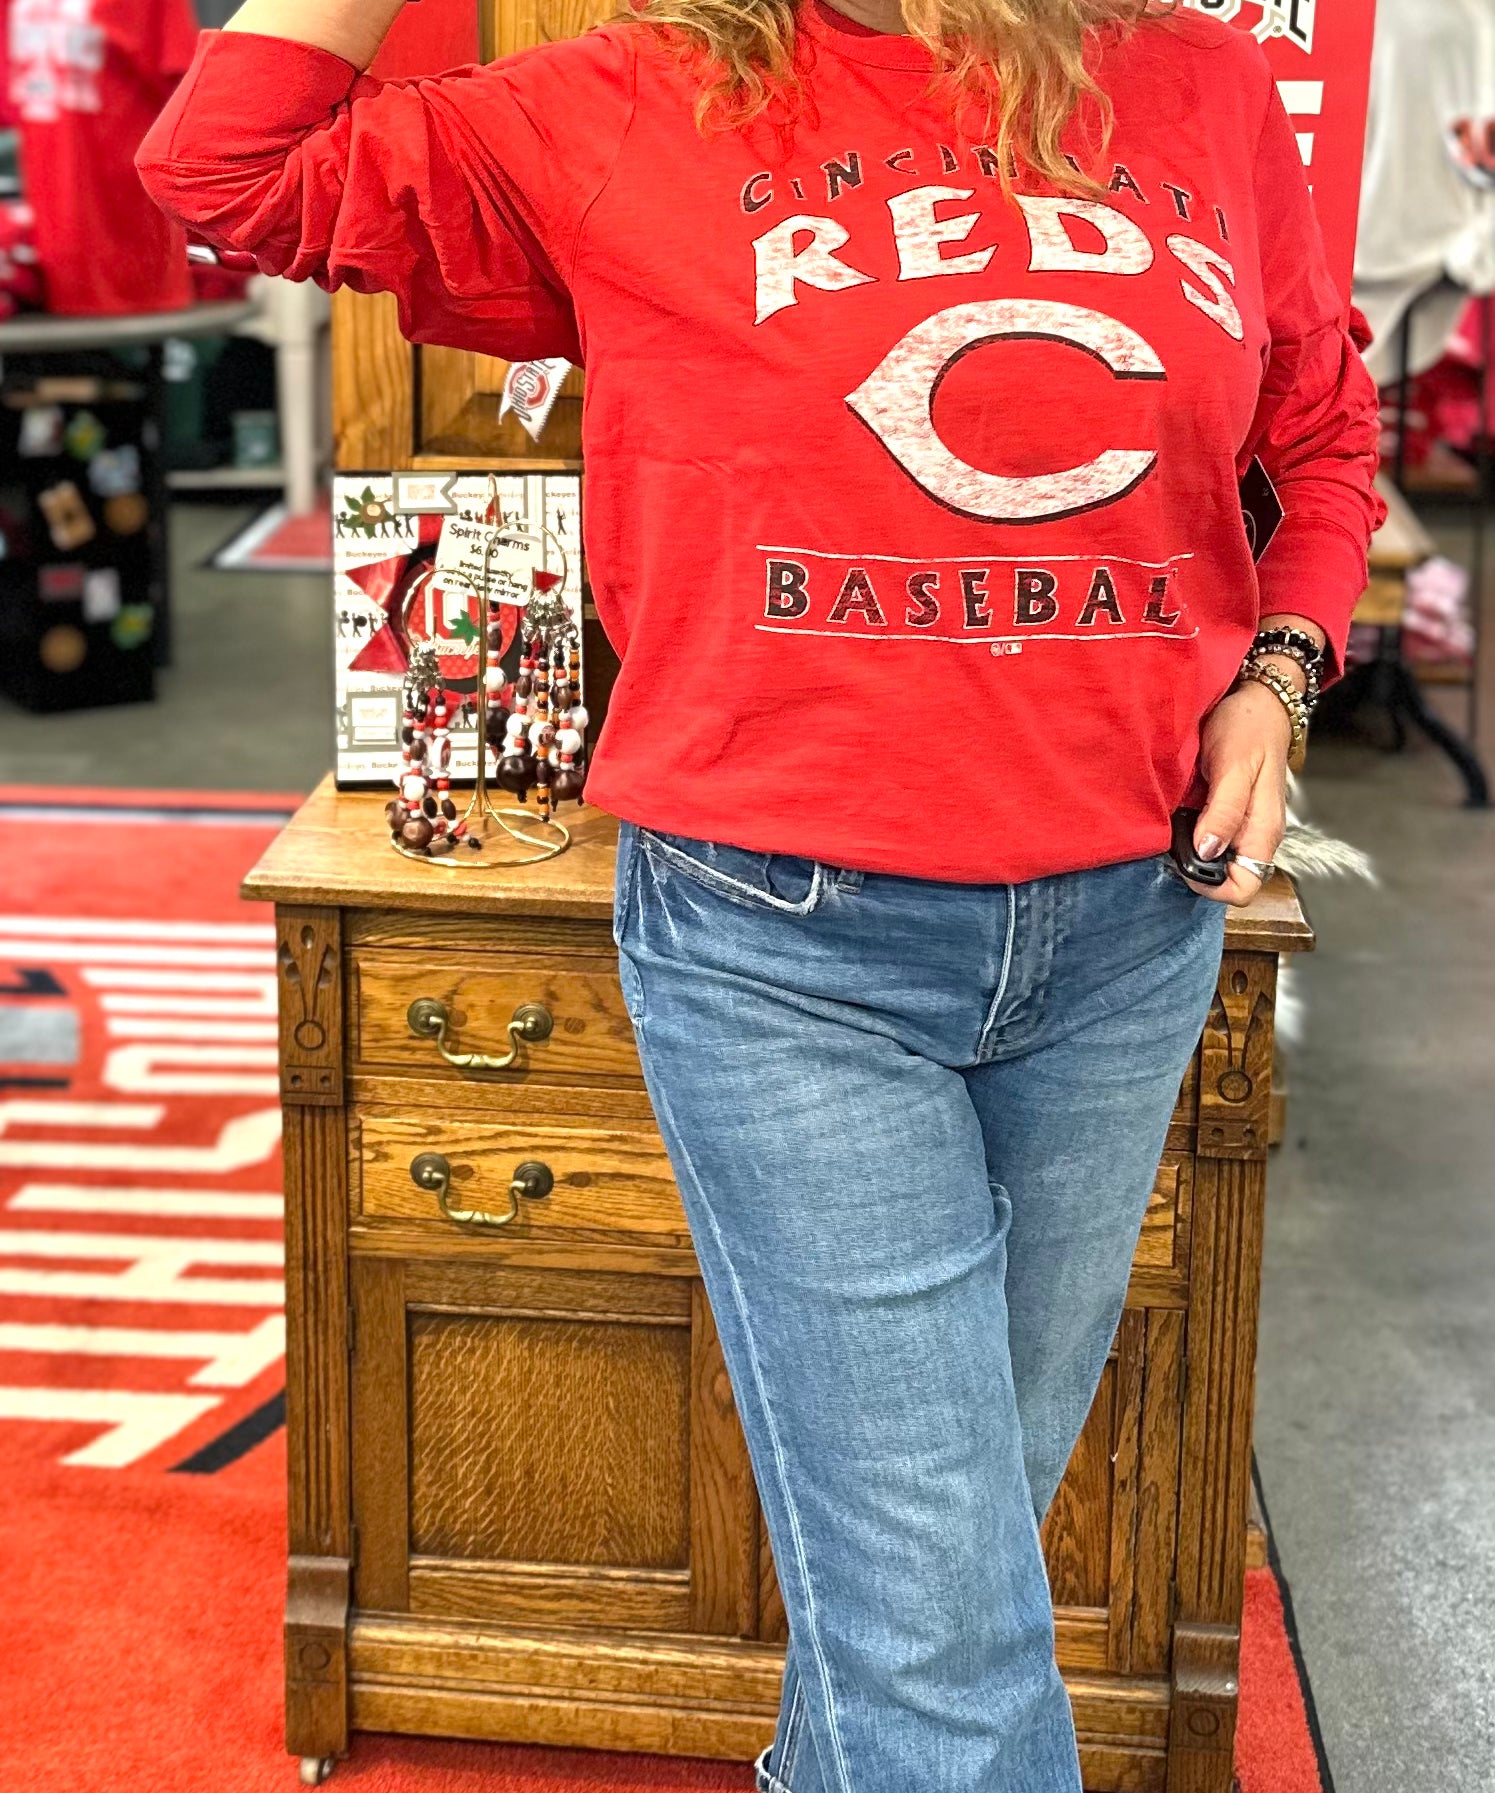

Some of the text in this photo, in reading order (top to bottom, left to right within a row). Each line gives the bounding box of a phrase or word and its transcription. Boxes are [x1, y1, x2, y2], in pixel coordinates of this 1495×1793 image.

[739, 141, 1231, 244] CINCINATI
[750, 185, 1245, 341] REDS
[843, 297, 1168, 527] C
[449, 523, 482, 541] Spirit
[470, 544, 499, 559] $6.0
[763, 556, 1181, 629] BASEBAL
